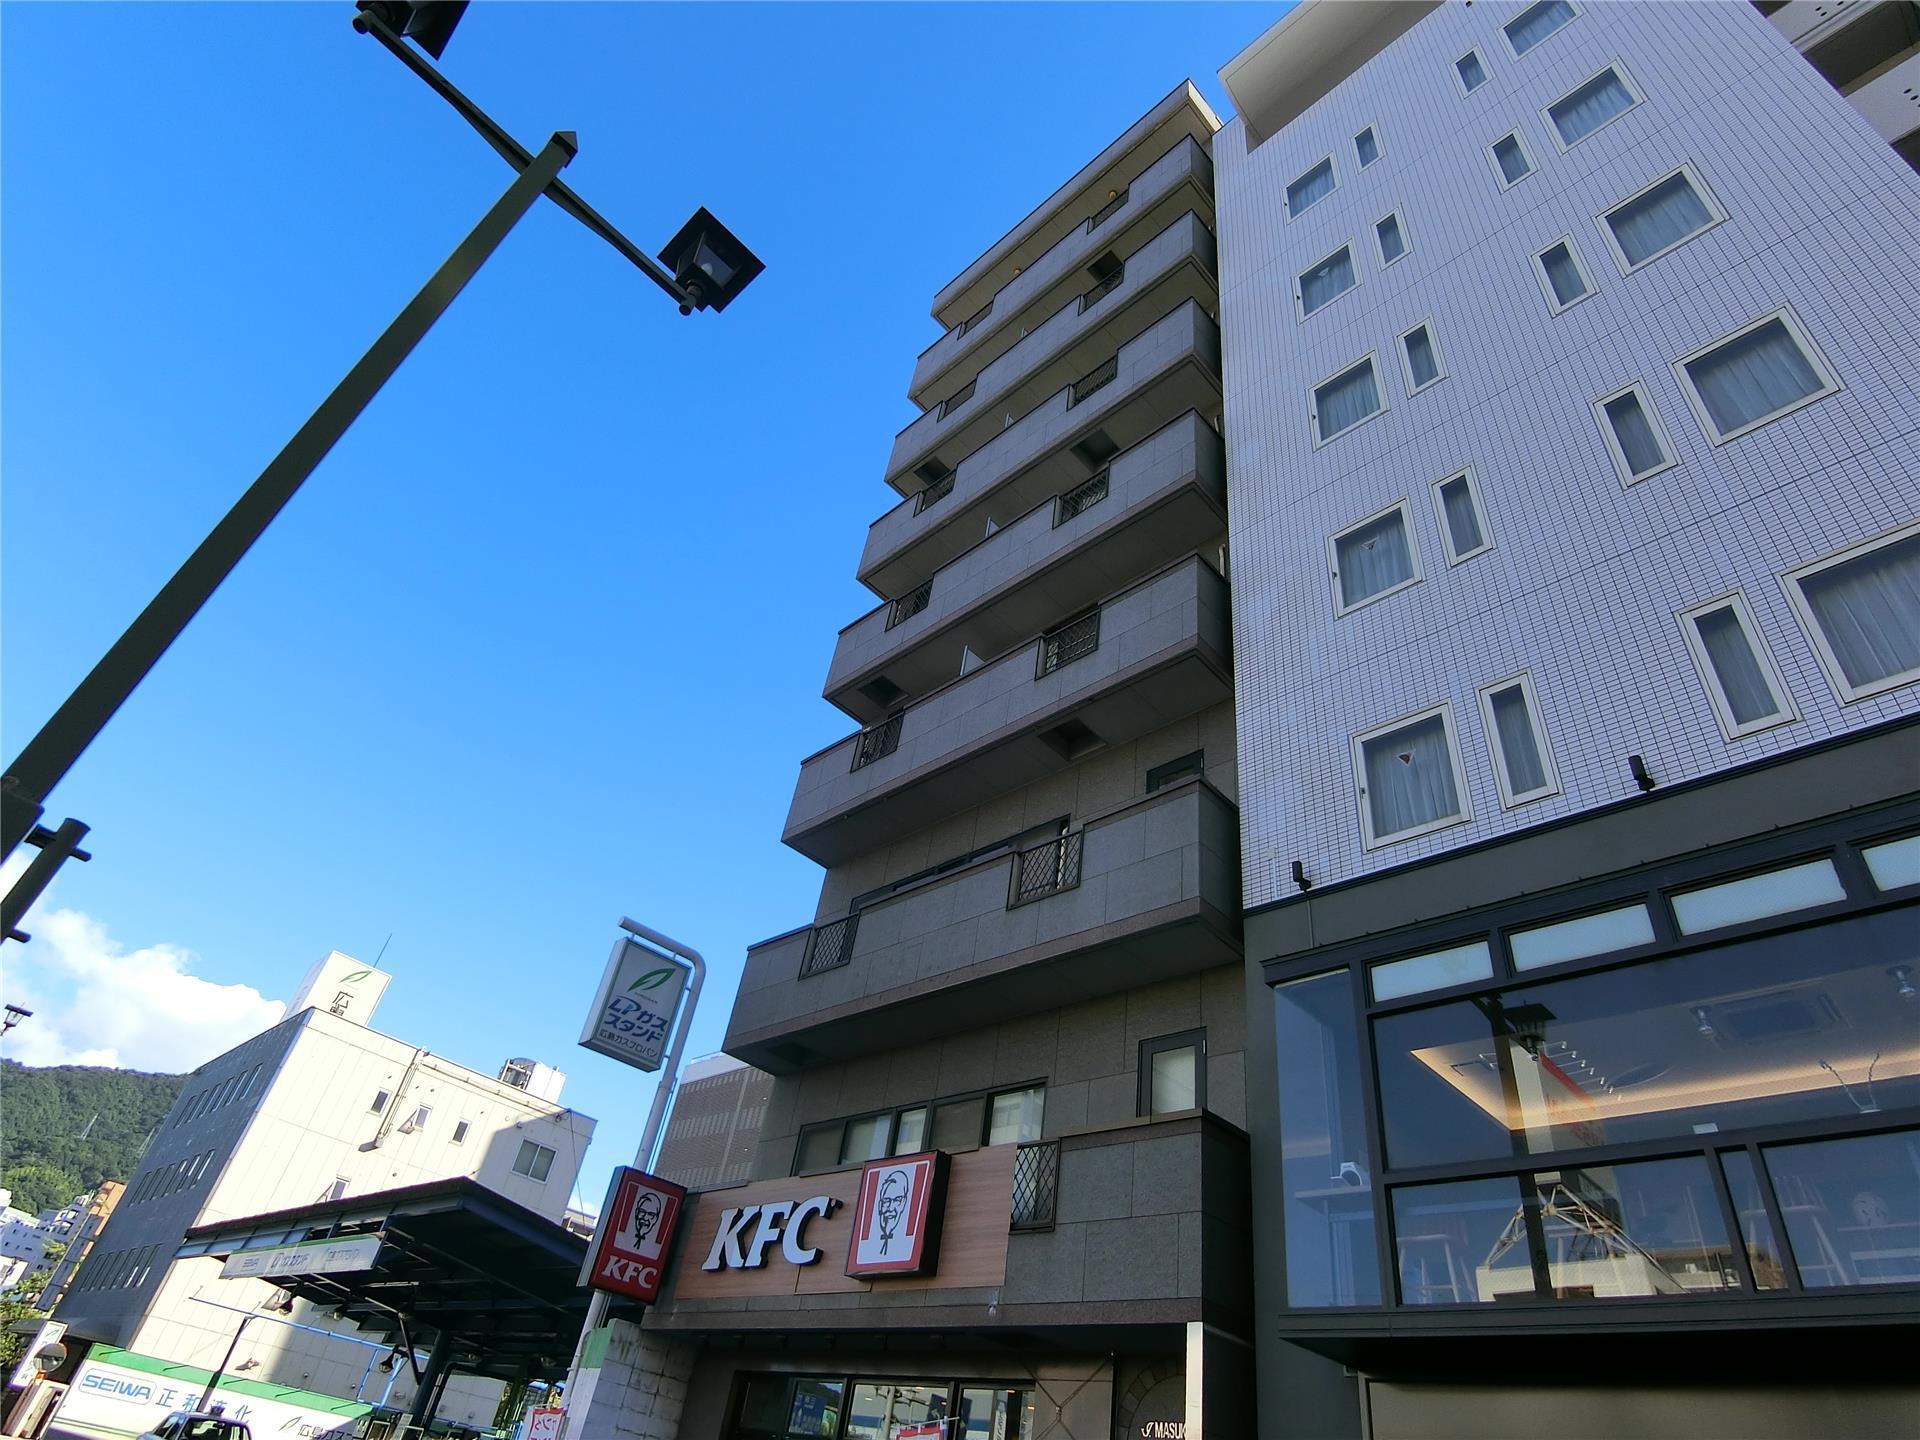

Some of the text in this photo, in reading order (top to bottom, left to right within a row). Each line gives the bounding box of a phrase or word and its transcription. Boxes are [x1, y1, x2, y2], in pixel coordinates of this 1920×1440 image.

[604, 1013, 663, 1042] スタンド
[701, 1195, 830, 1270] KFC
[601, 1254, 658, 1289] KFC
[82, 1374, 151, 1400] SEIWA
